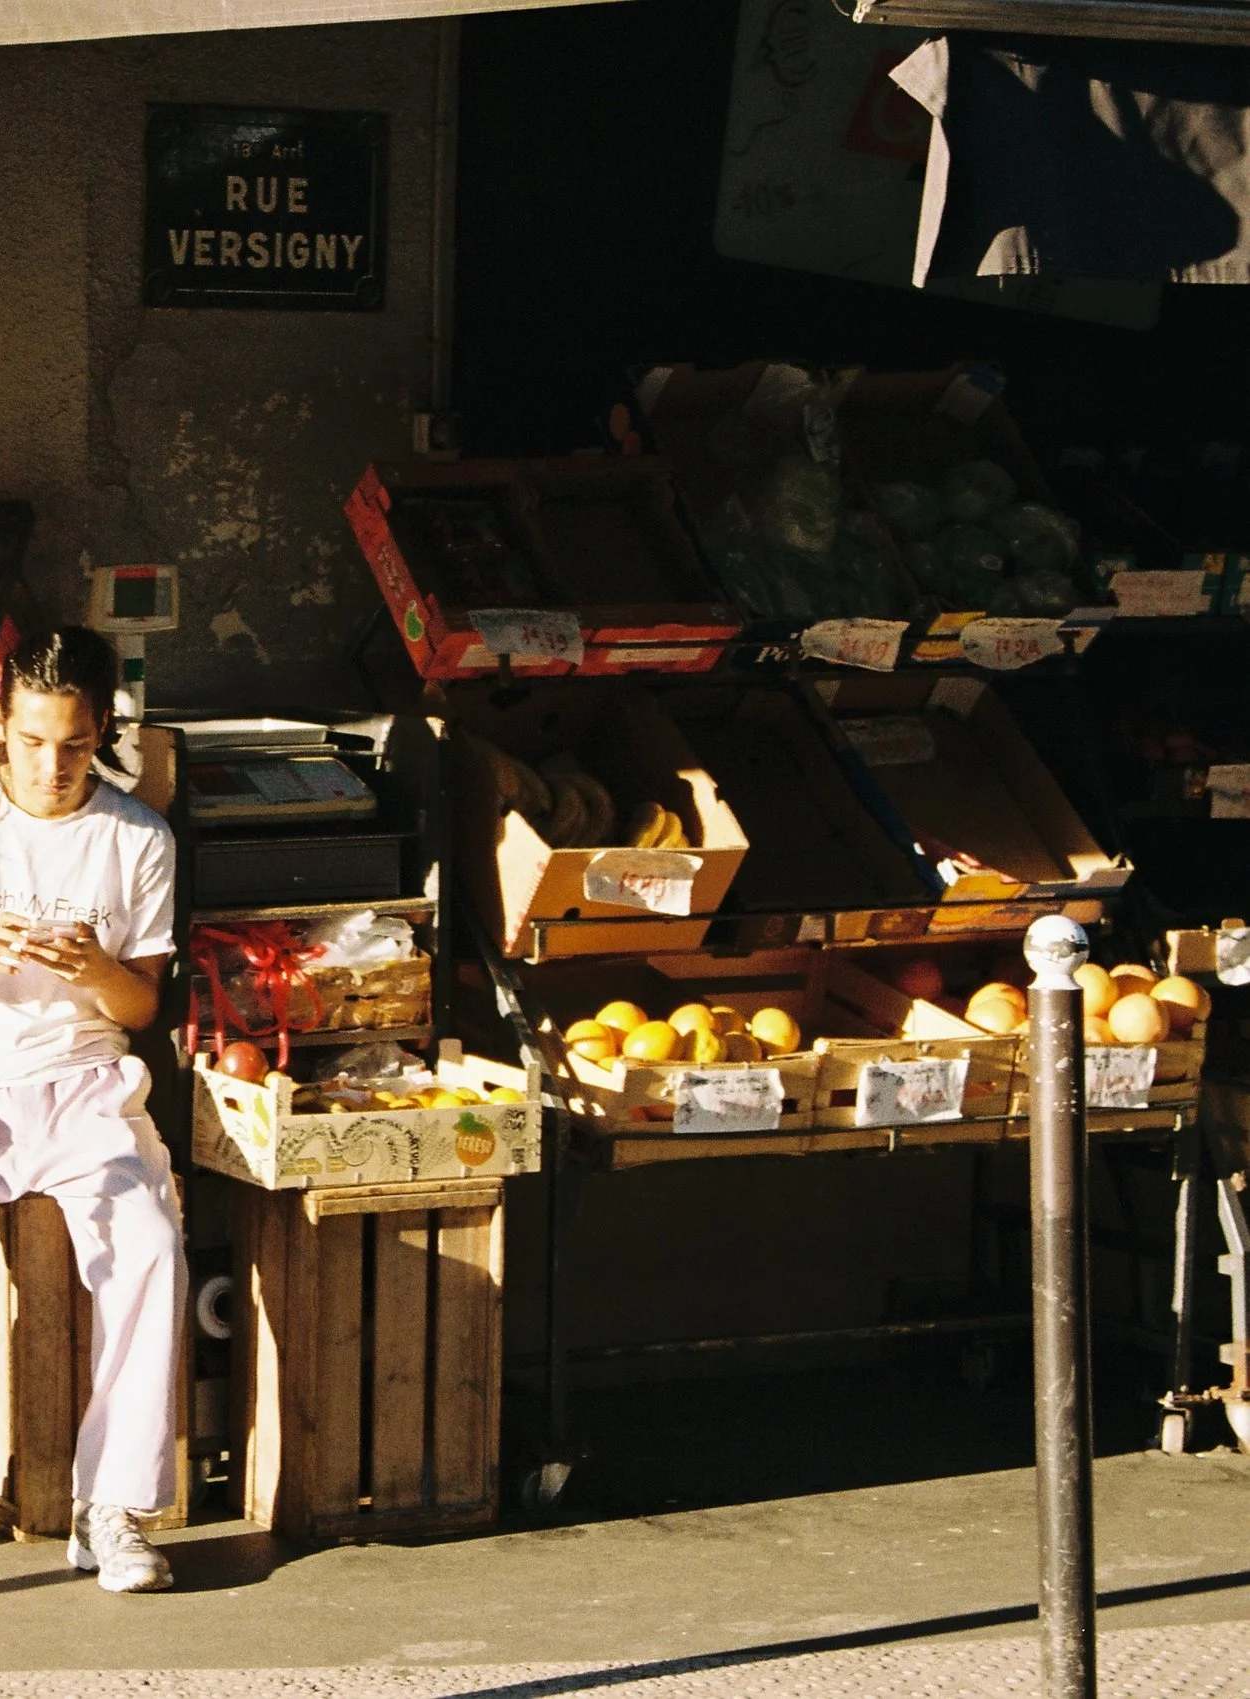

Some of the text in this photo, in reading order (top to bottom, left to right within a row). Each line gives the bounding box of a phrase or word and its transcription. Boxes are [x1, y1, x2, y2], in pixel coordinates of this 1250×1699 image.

[225, 174, 309, 214] RUE
[167, 228, 364, 271] VERSIGNY
[19, 892, 51, 921] My
[53, 896, 113, 929] Freak
